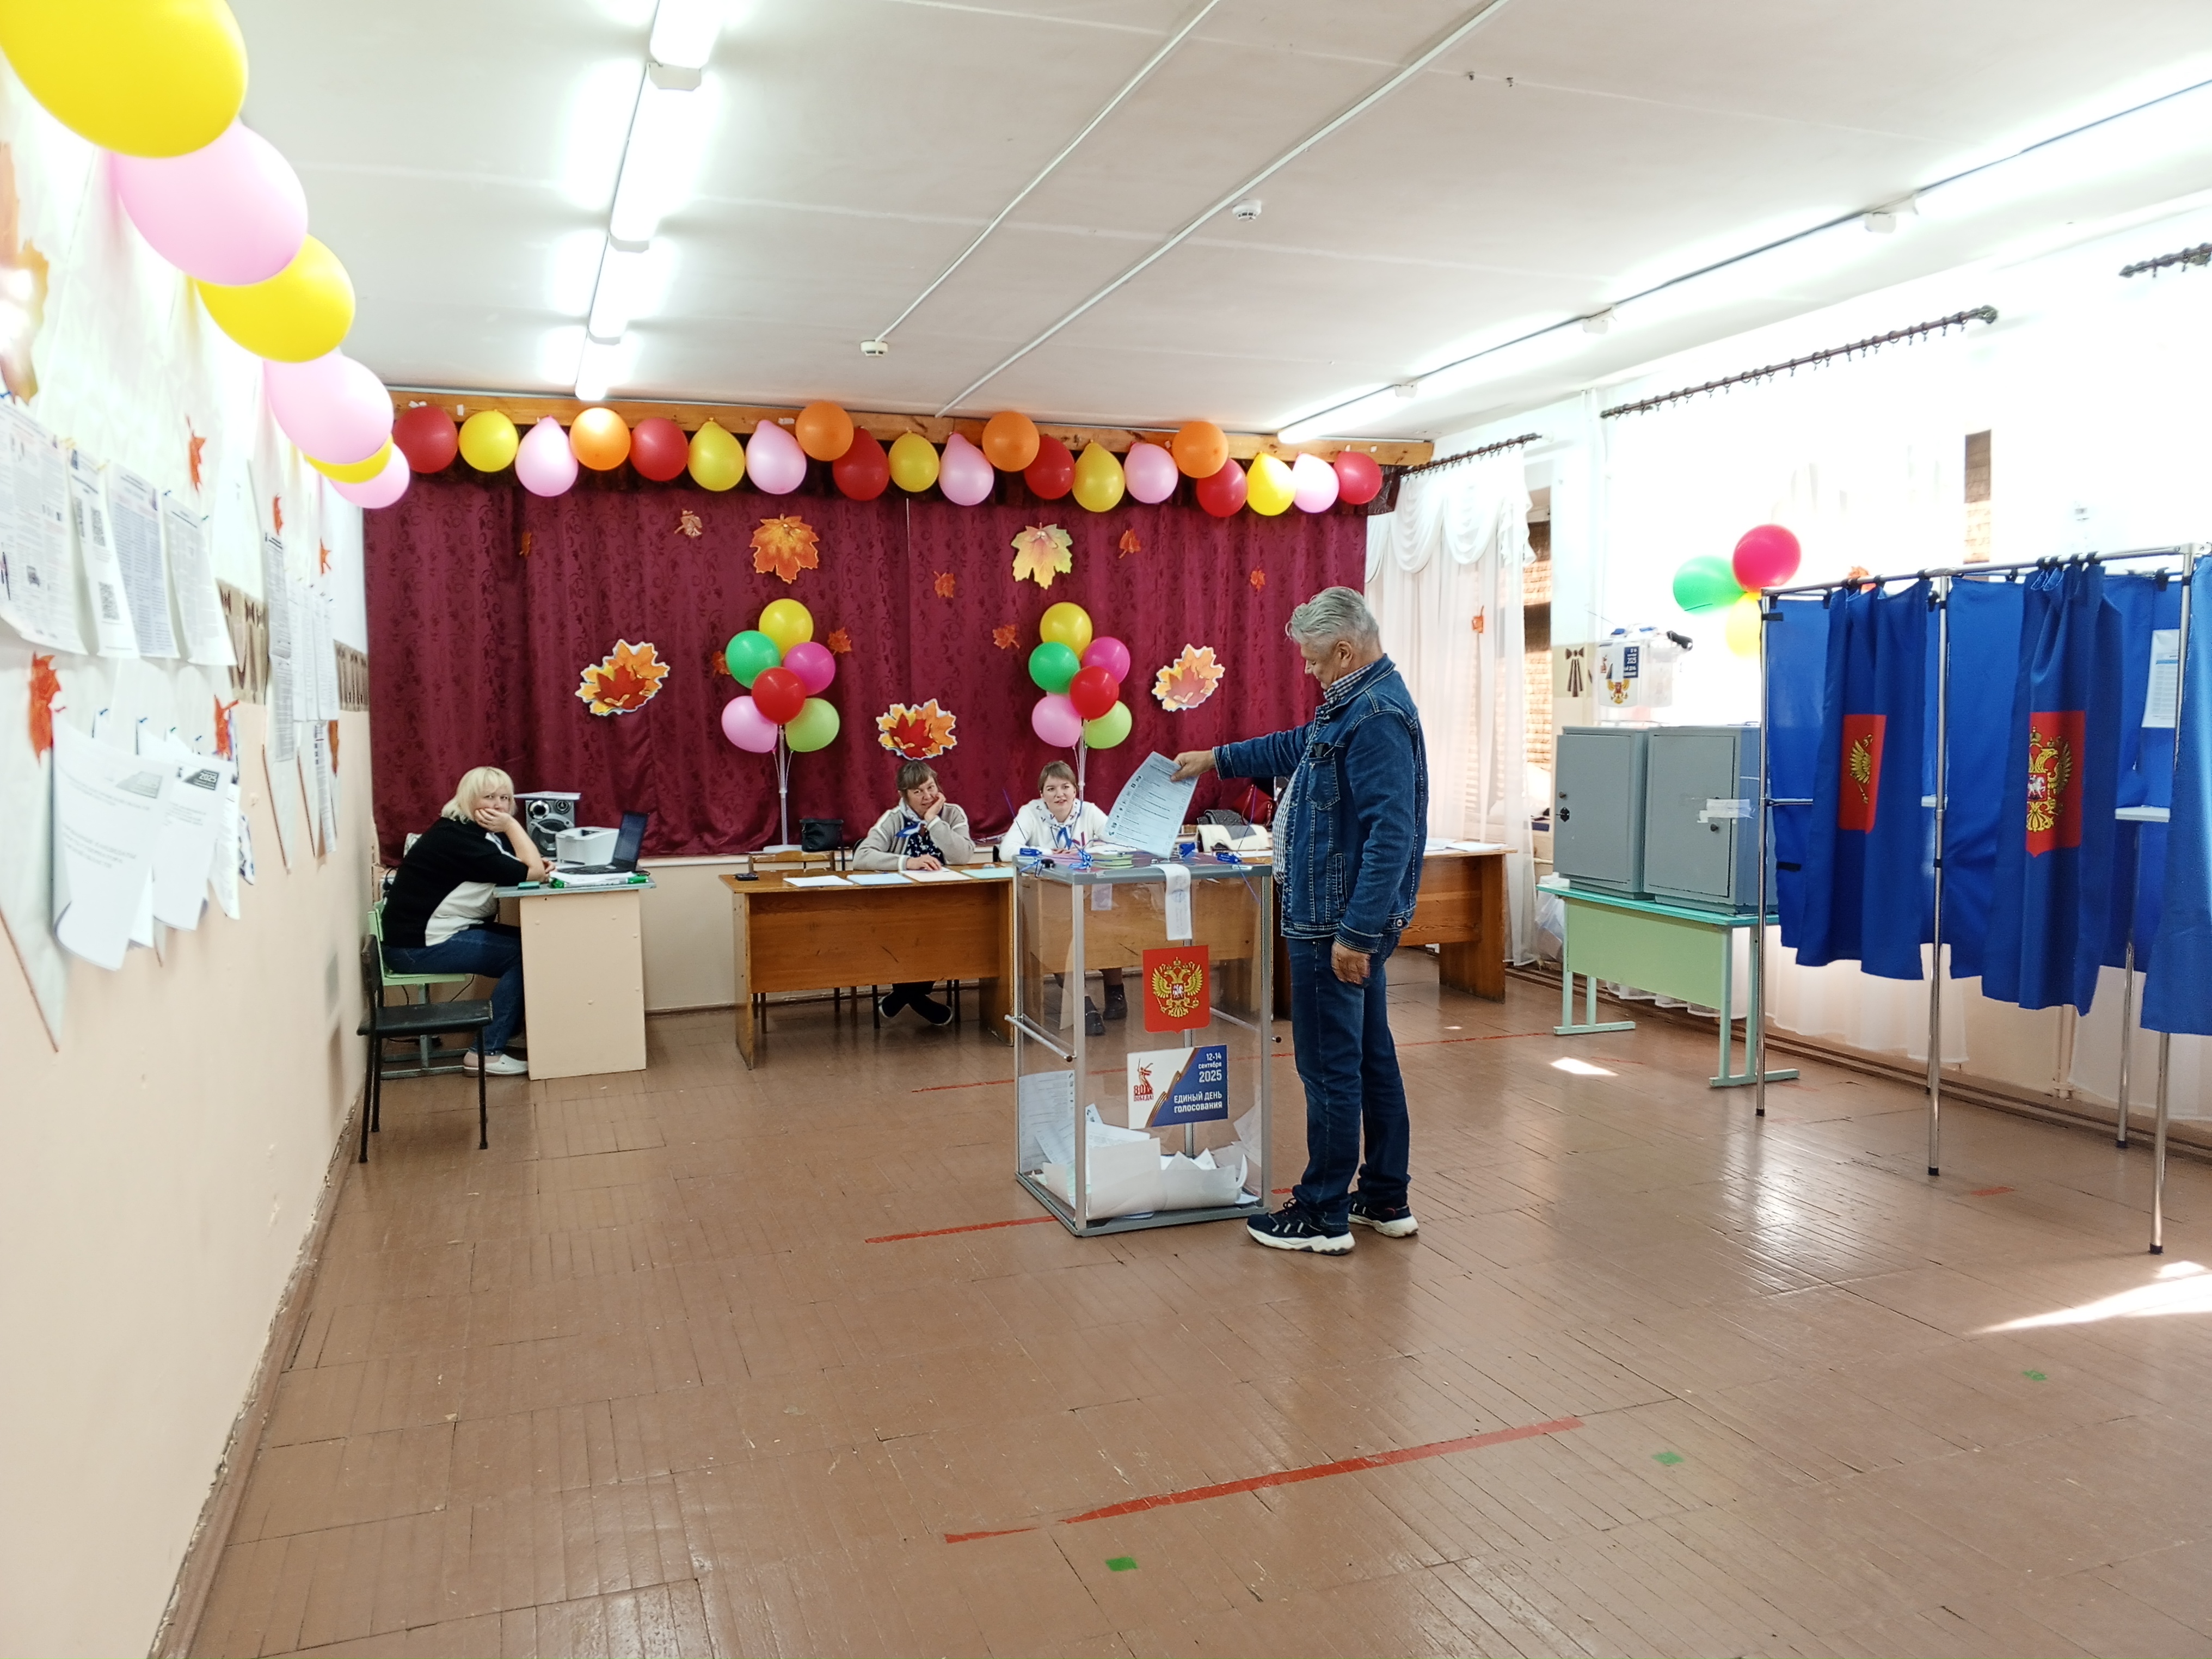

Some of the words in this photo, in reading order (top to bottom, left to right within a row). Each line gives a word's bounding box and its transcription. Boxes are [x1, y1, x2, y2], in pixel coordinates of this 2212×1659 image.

[1199, 1069, 1222, 1083] 2025
[1174, 1091, 1203, 1104] ЕДИНЫЙ
[1204, 1091, 1222, 1101] ДЕНЬ
